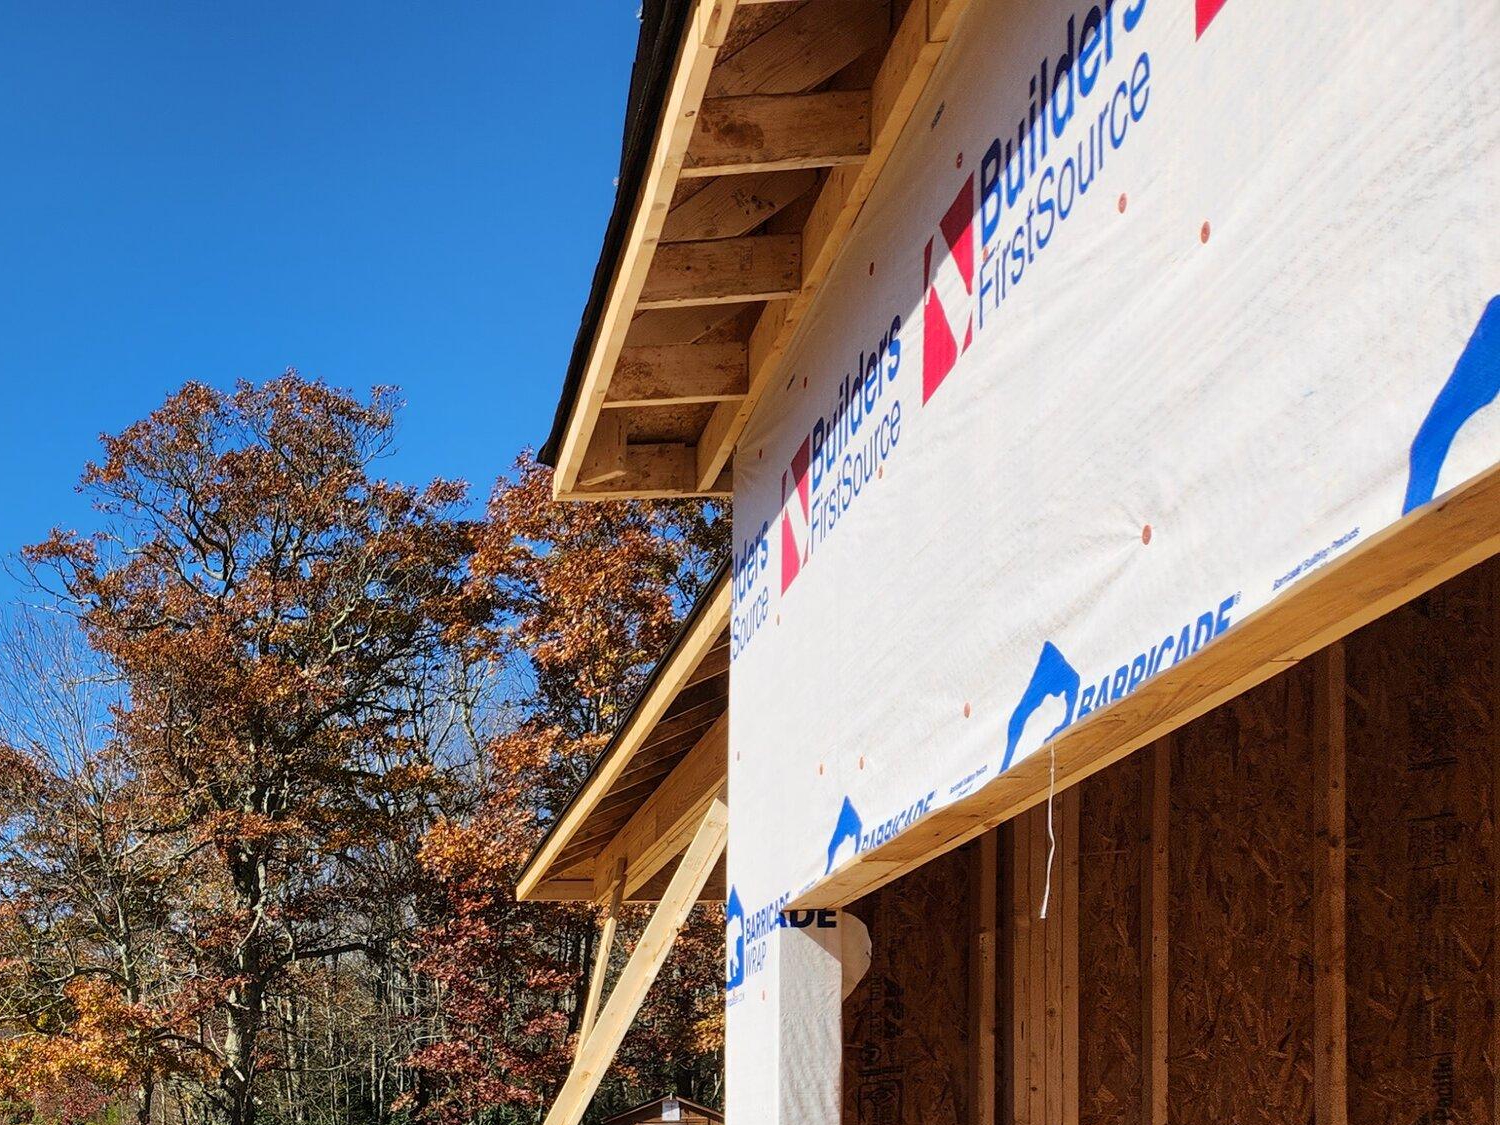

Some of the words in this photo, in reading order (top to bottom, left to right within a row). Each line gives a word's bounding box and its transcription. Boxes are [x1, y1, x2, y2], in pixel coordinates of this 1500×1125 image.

[979, 52, 1150, 330] FirstSource
[811, 400, 902, 554] FirstSource
[812, 315, 902, 495] Builders
[1077, 594, 1236, 719] BARRICADE
[746, 941, 767, 978] WRAP
